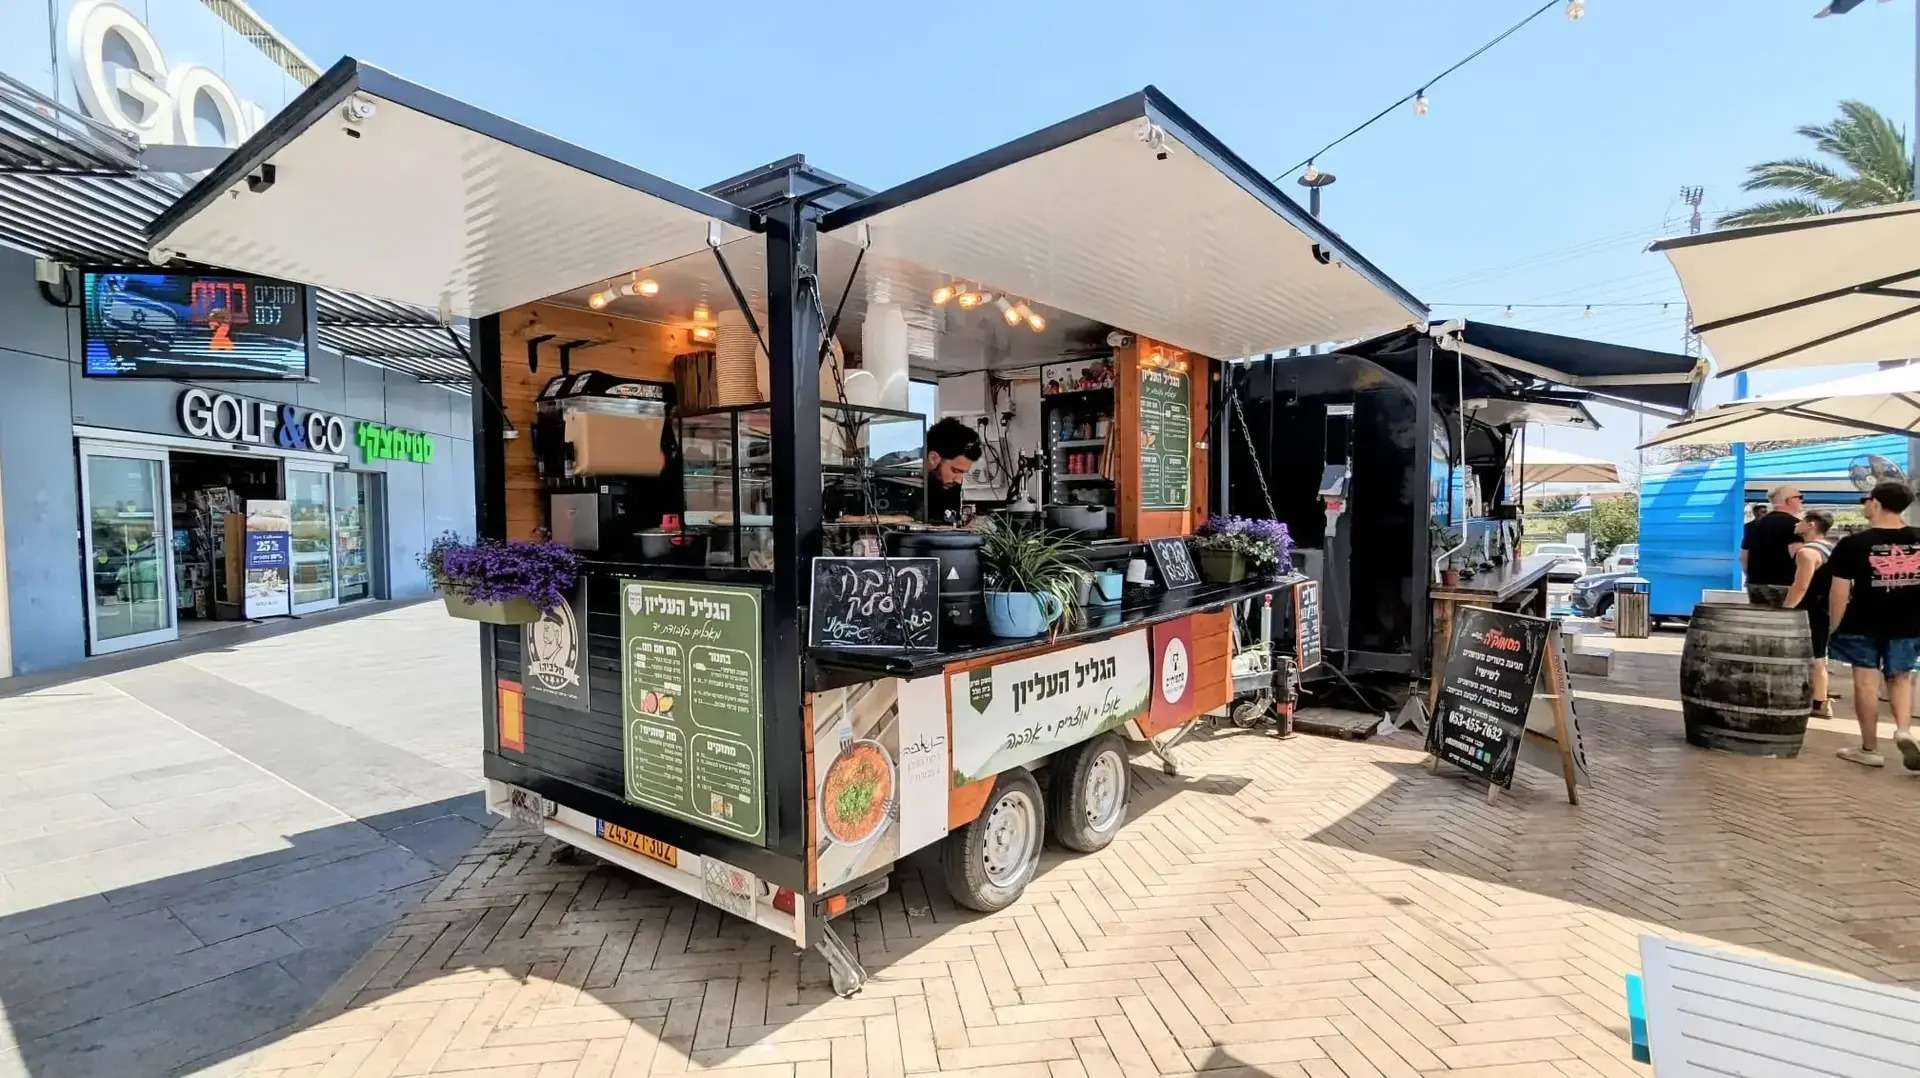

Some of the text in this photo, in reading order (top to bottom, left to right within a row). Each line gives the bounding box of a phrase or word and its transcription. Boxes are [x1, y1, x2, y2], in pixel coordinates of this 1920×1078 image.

[357, 421, 434, 465] סטימצקי
[644, 593, 685, 616] העליון
[689, 596, 730, 621] הגליל
[652, 619, 722, 643] מאכלים בעבודת יד
[708, 652, 732, 665] בתנור
[1012, 655, 1116, 714] הגליל העליון
[1006, 686, 1121, 750] אוכל מוצרים אהבה
[1449, 710, 1503, 742] 053-455-7632
[707, 740, 736, 757] מתוקים
